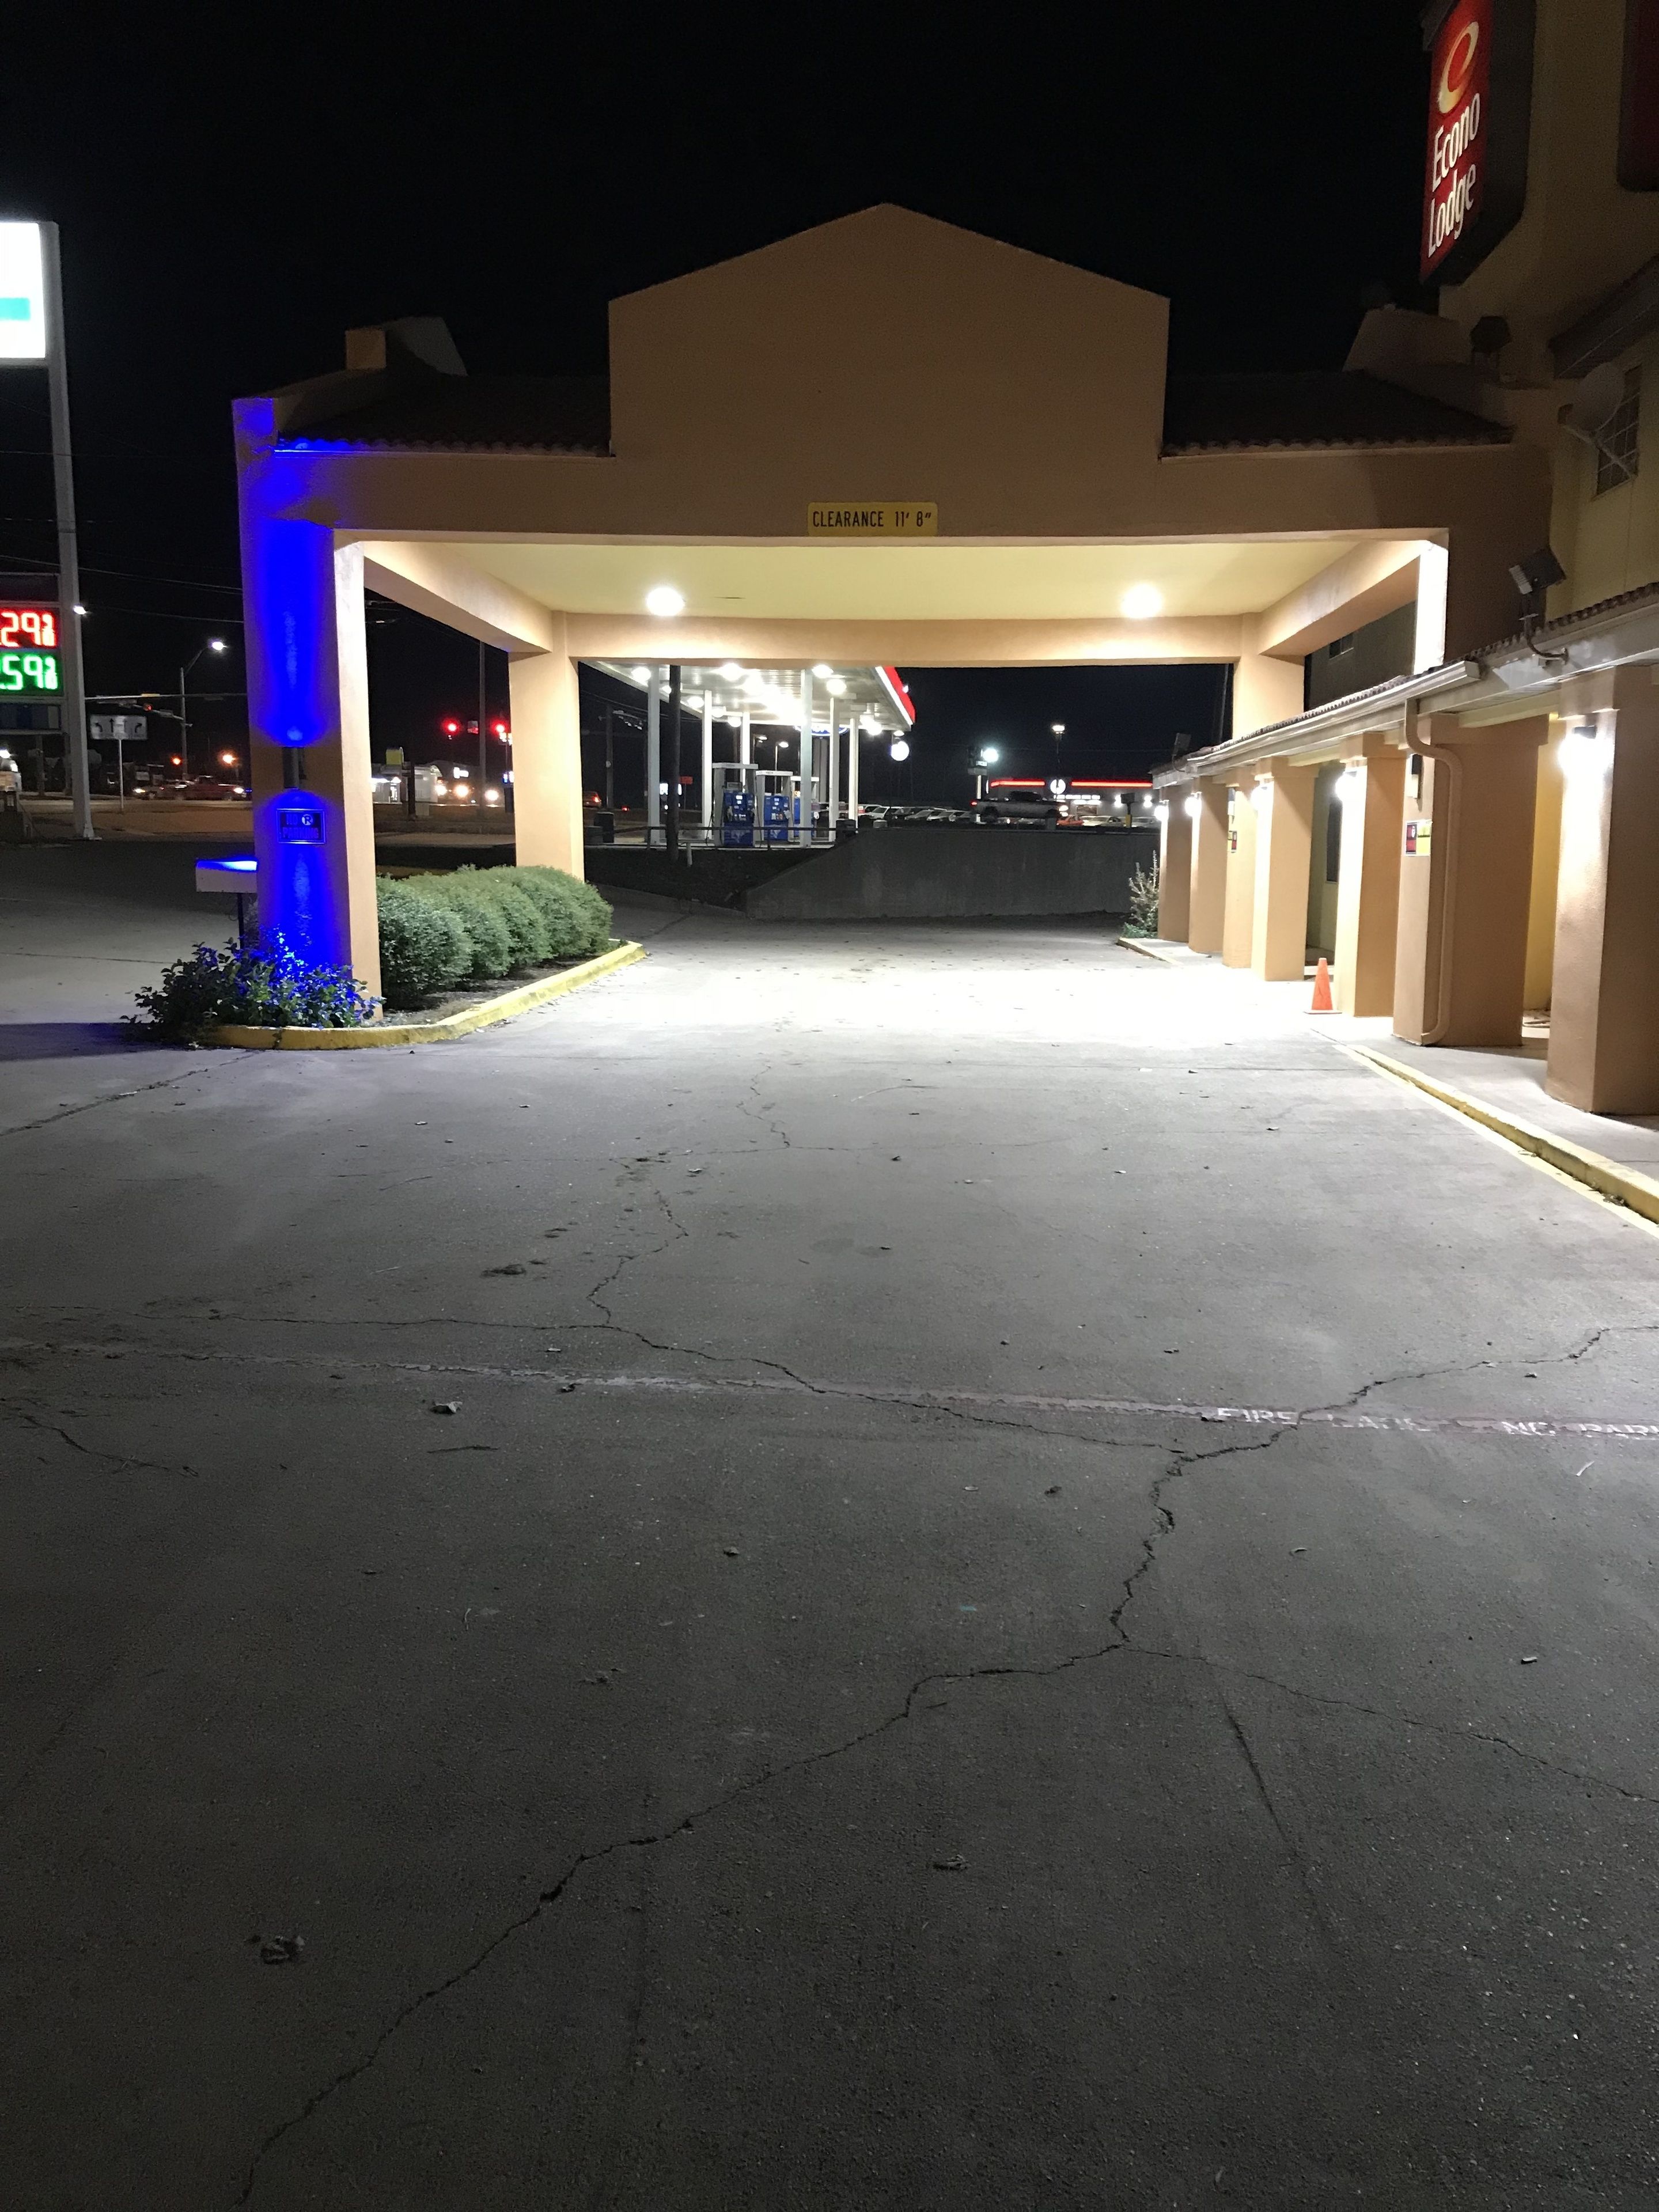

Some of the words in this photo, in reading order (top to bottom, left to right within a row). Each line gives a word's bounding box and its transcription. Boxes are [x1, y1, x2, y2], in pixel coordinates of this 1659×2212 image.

[1432, 92, 1480, 192] Econo
[1428, 164, 1476, 258] Lodge
[812, 510, 884, 527] CLEARANCE
[1217, 1407, 1298, 1425] FIRE
[1578, 1423, 1659, 1440] PAR
